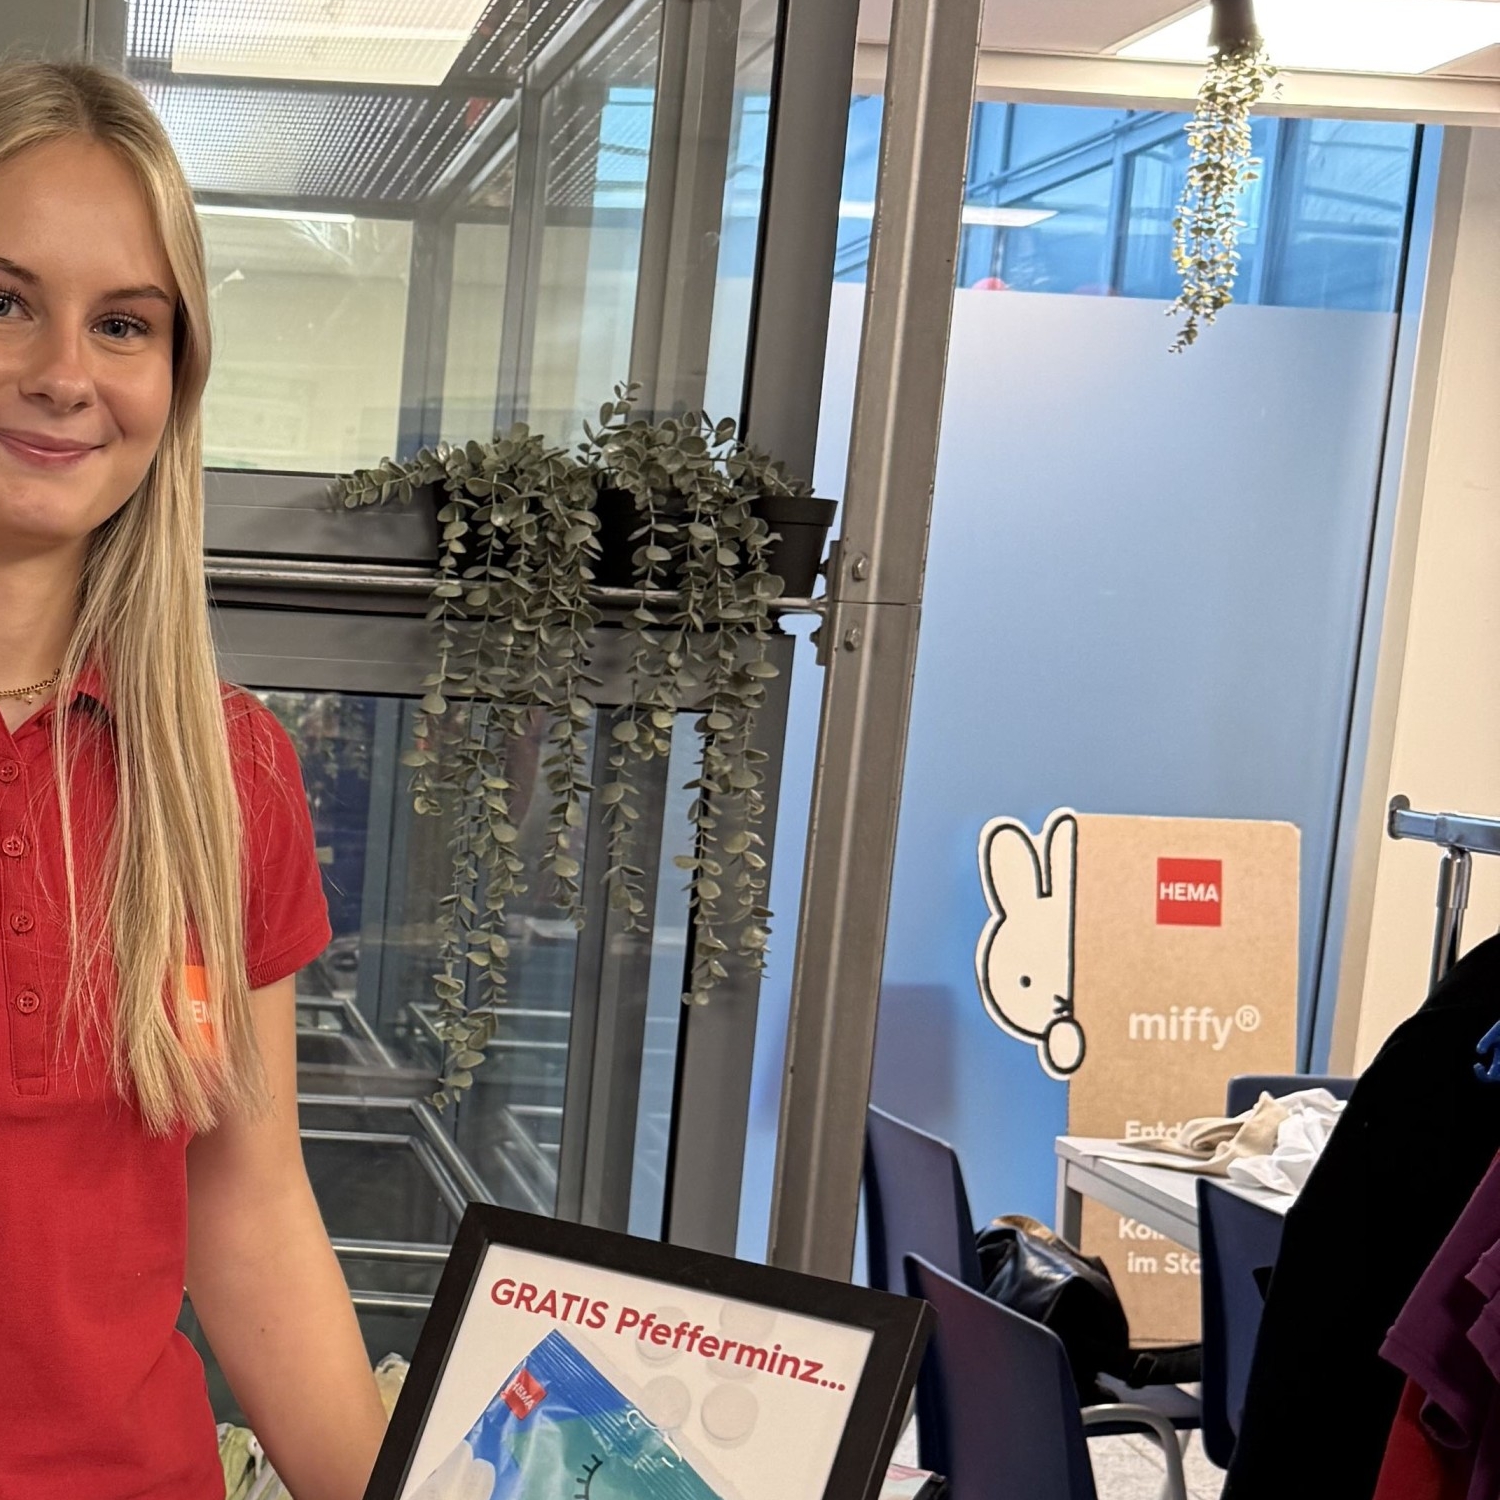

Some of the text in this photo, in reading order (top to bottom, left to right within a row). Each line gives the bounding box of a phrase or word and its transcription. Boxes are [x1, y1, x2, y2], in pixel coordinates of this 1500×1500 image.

[1159, 881, 1219, 903] HEMA
[1127, 1252, 1157, 1274] im
[490, 1278, 846, 1392] GRATIS Pfefferminz...
[509, 1381, 535, 1411] HEMA
